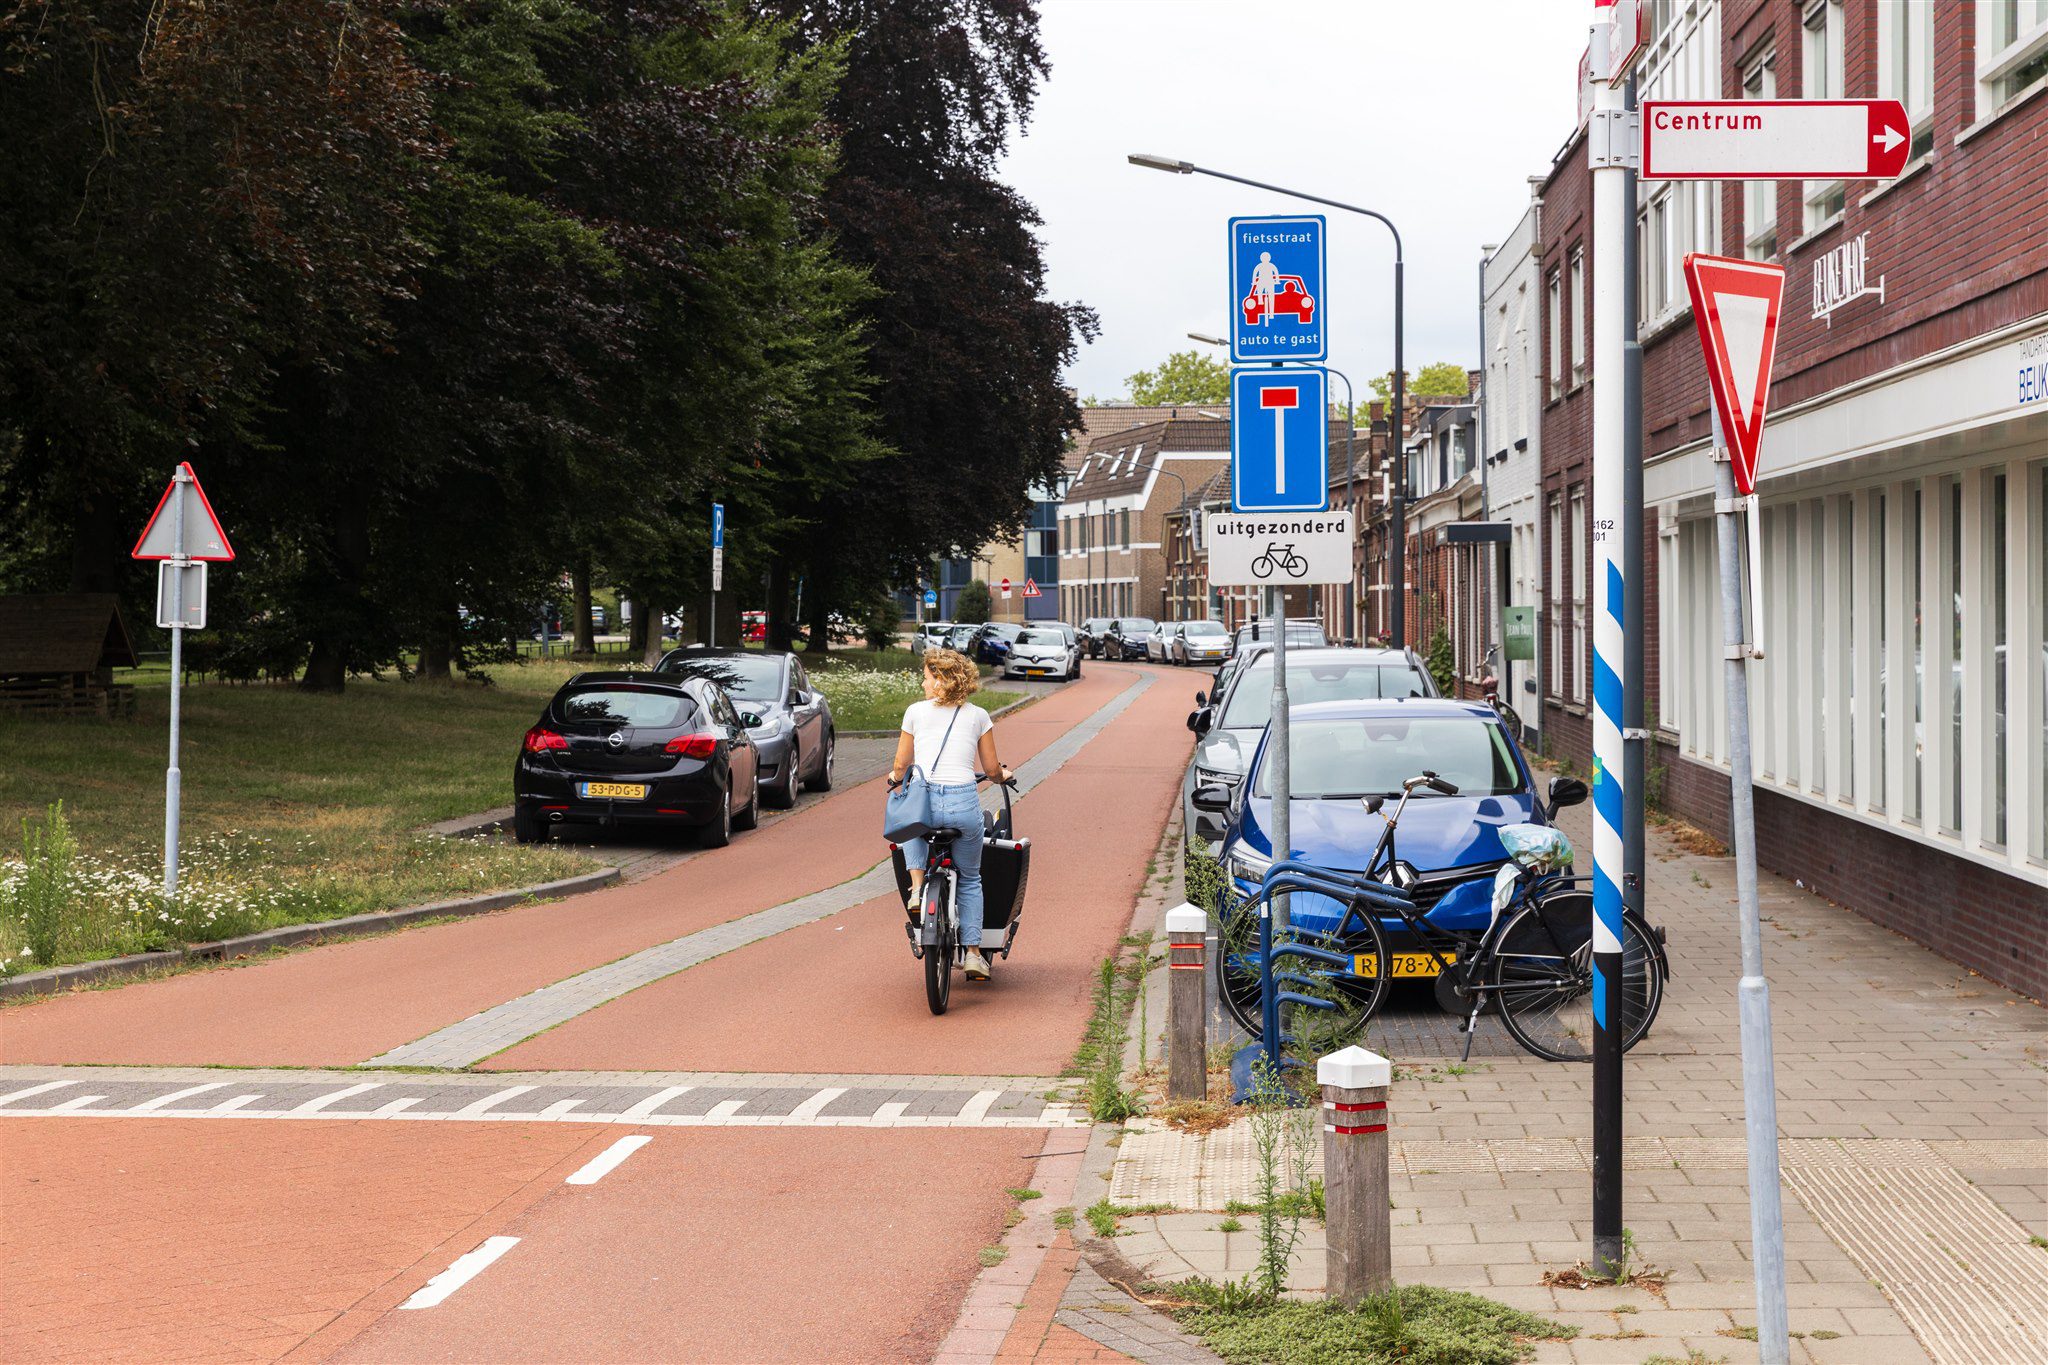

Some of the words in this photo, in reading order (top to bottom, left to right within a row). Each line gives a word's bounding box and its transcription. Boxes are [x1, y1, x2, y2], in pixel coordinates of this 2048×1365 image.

[1654, 111, 1762, 130] Centrum
[1243, 232, 1312, 244] fietsstraat
[1813, 231, 1871, 309] BEUKENHOF
[1240, 335, 1270, 345] auto
[1273, 334, 1287, 345] te
[1290, 333, 1318, 347] gast
[1217, 519, 1345, 539] uitgezonderd
[590, 784, 641, 796] 53-PDG-5
